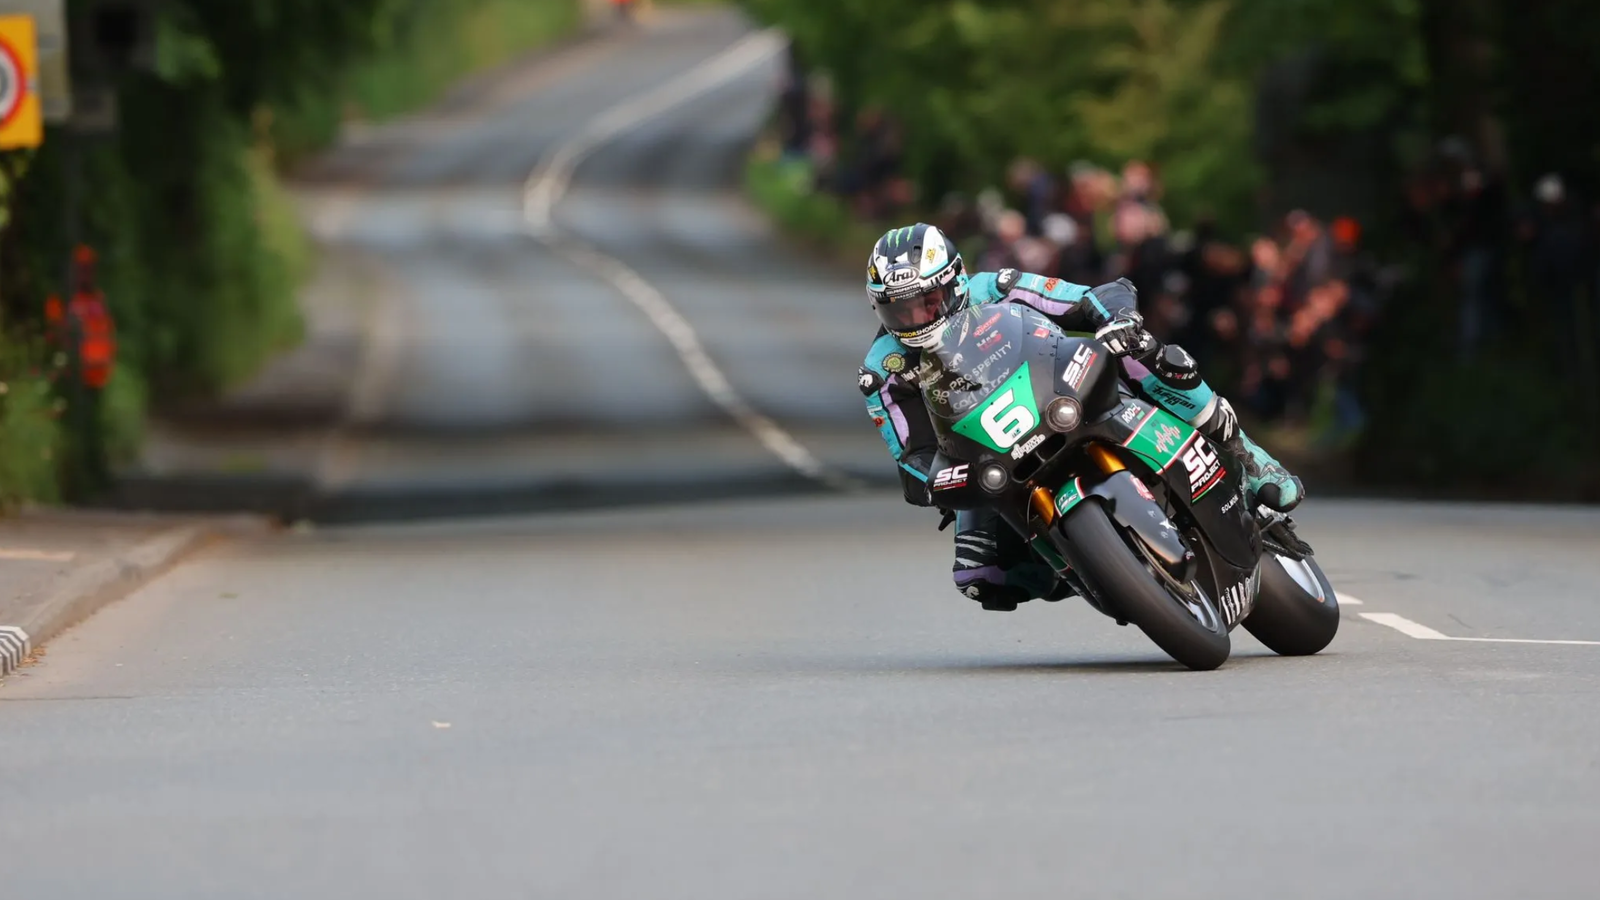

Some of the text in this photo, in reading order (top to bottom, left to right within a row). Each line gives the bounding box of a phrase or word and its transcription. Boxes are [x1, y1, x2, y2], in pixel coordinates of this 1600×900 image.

[887, 269, 914, 284] Arai
[1062, 343, 1090, 387] SC
[980, 388, 1034, 449] 6
[934, 464, 969, 483] SC
[1182, 436, 1216, 485] SC
[1191, 459, 1220, 493] PROJECT
[933, 478, 967, 488] PROJECT
